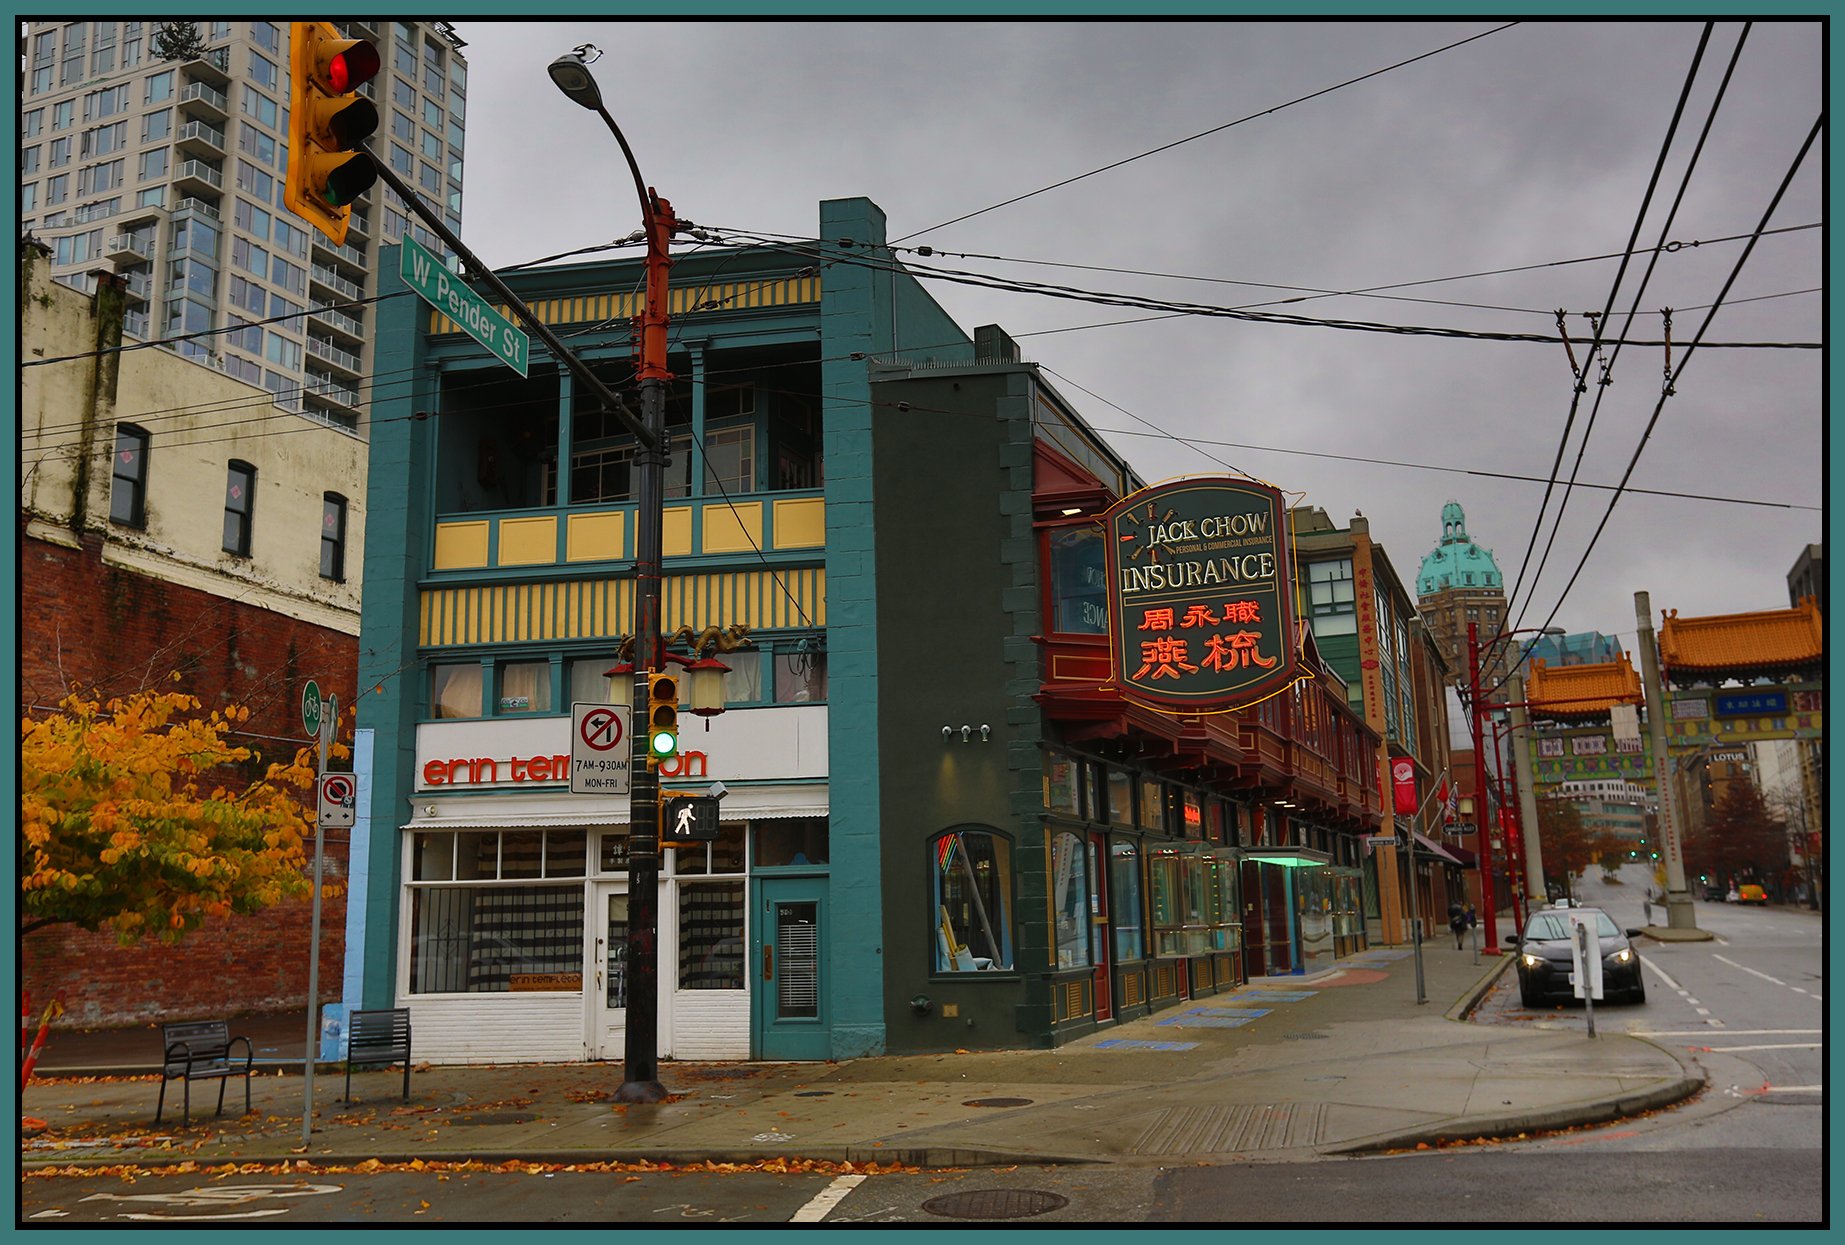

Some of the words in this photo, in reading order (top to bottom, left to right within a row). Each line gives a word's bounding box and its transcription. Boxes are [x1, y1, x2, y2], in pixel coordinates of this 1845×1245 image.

[412, 249, 431, 288] W
[437, 271, 497, 343] Pender
[502, 328, 520, 363] St
[1146, 519, 1200, 549] JACK
[1200, 511, 1269, 539] CHOW
[1175, 543, 1202, 554] PERSONAL
[1207, 538, 1242, 550] COMMERCIAL
[1242, 535, 1273, 546] INSURANCE
[1121, 552, 1275, 592] INSURANCE
[1137, 600, 1264, 631] 周永職
[423, 757, 497, 785] erin
[511, 750, 707, 783] temon
[1713, 753, 1745, 762] LOTUS
[585, 778, 618, 788] MON-FRI
